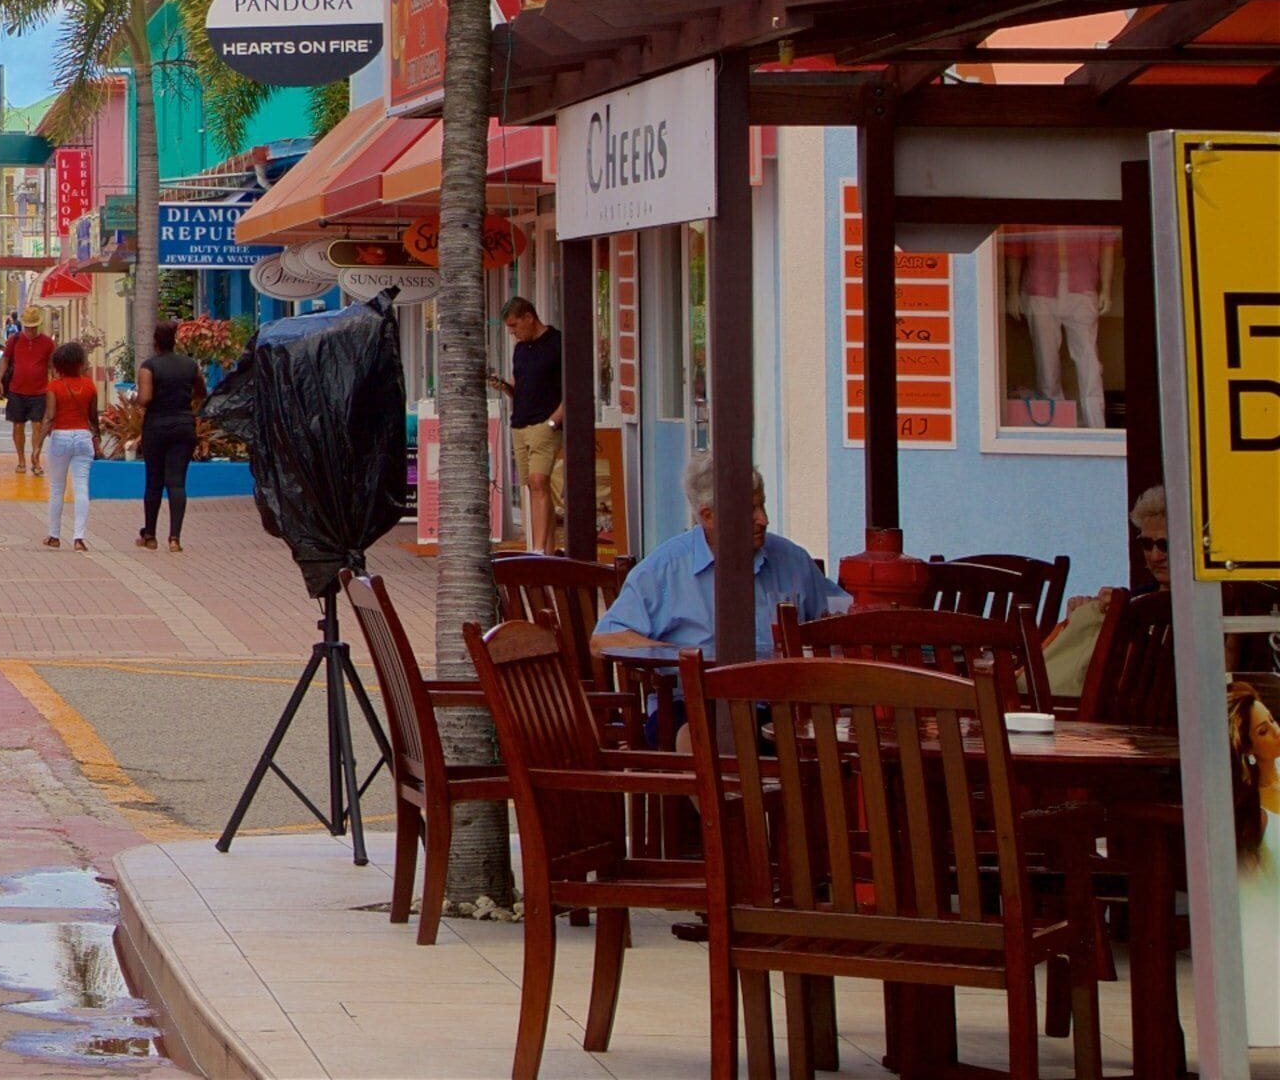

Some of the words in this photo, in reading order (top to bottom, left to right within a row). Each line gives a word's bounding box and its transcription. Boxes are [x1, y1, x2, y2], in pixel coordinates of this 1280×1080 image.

[223, 41, 296, 55] HEARTS
[298, 40, 327, 54] ON
[329, 39, 369, 52] FIRE
[60, 159, 71, 227] LIQUOR
[71, 189, 79, 197] &
[189, 245, 221, 254] DUTY
[222, 245, 251, 254] FREE
[165, 254, 214, 264] JEWELRY
[215, 254, 225, 264] &
[349, 274, 436, 288] SUNGLASSES
